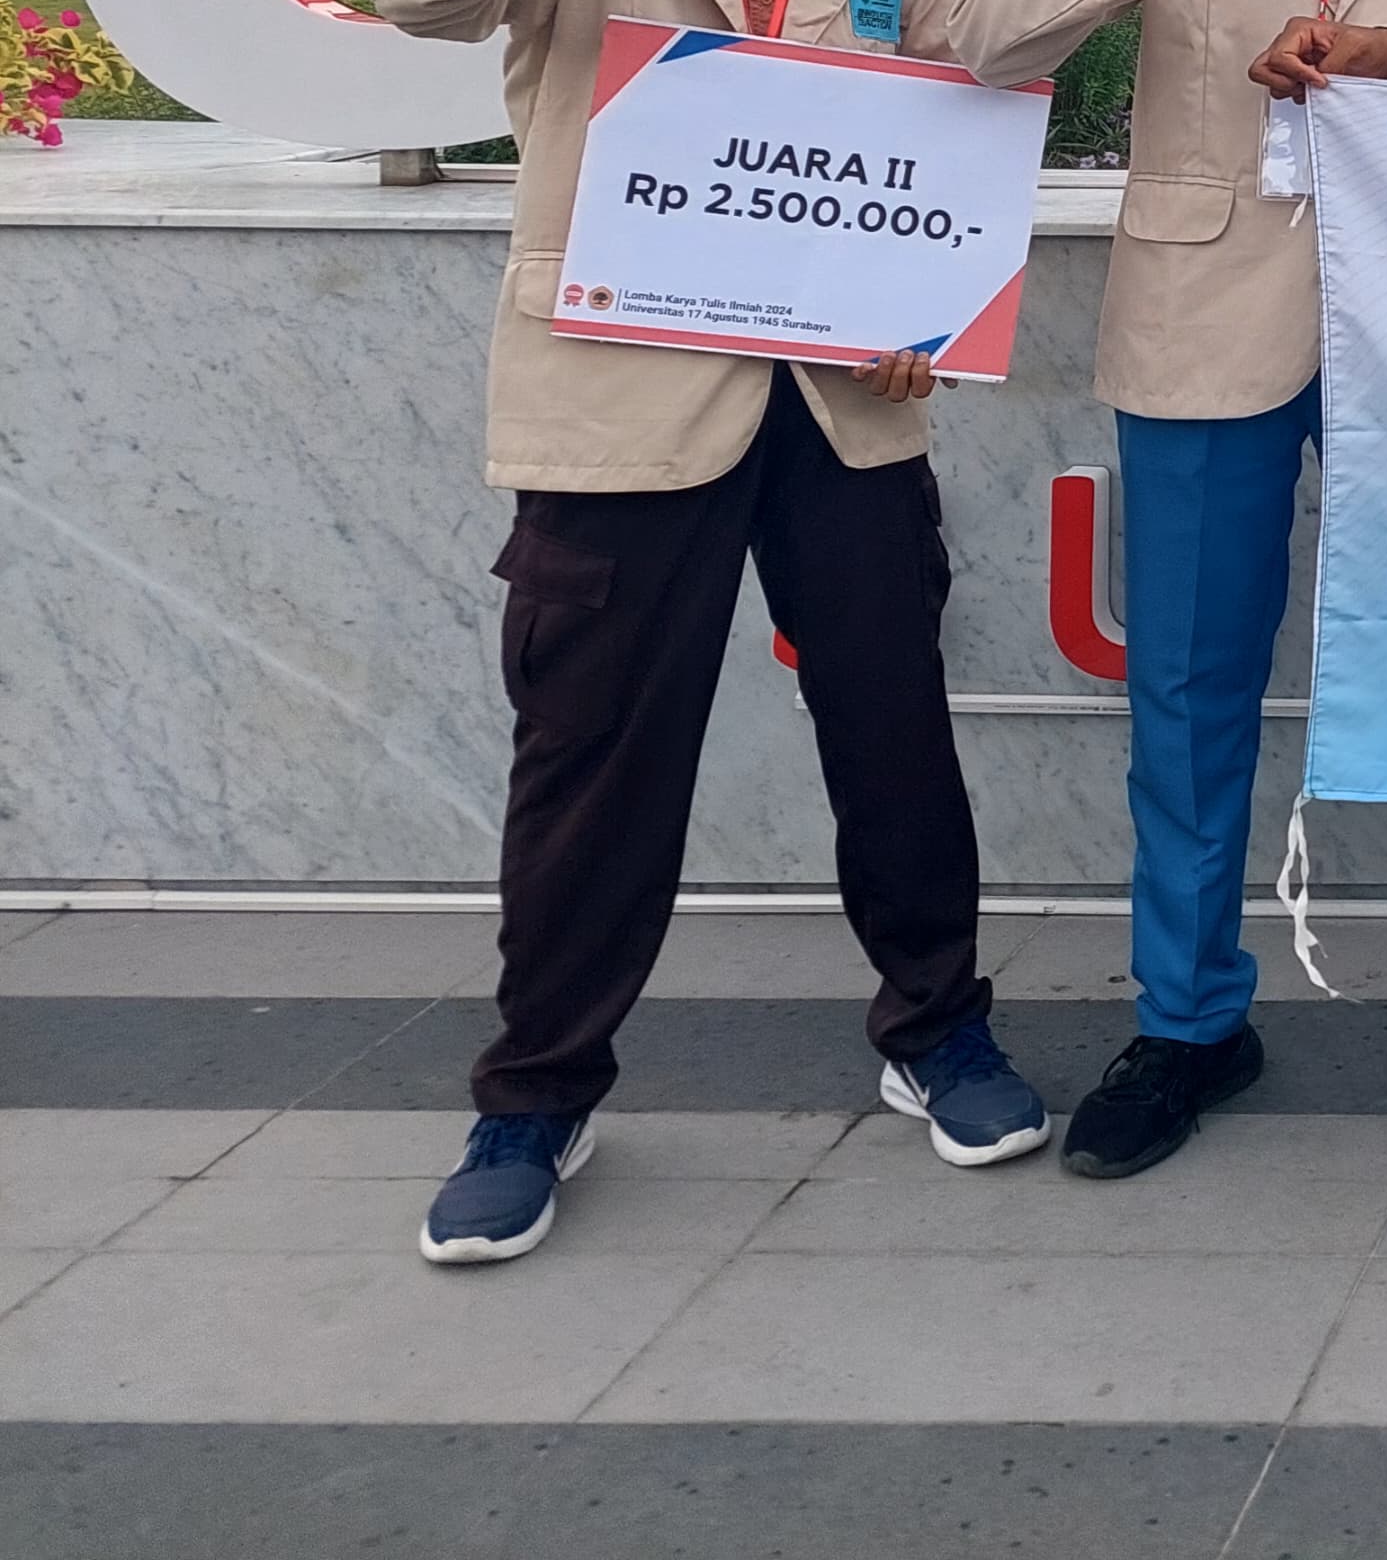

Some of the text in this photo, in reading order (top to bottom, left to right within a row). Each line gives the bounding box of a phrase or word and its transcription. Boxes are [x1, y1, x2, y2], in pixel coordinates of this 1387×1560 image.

[713, 137, 916, 191] JUARA II
[625, 172, 982, 248] Rp 2.500.000,-
[622, 302, 832, 333] Universitas 17 Agustus 1945 Surabaya
[624, 289, 793, 316] Lomba Karya Tulis Ilmiah 2024
